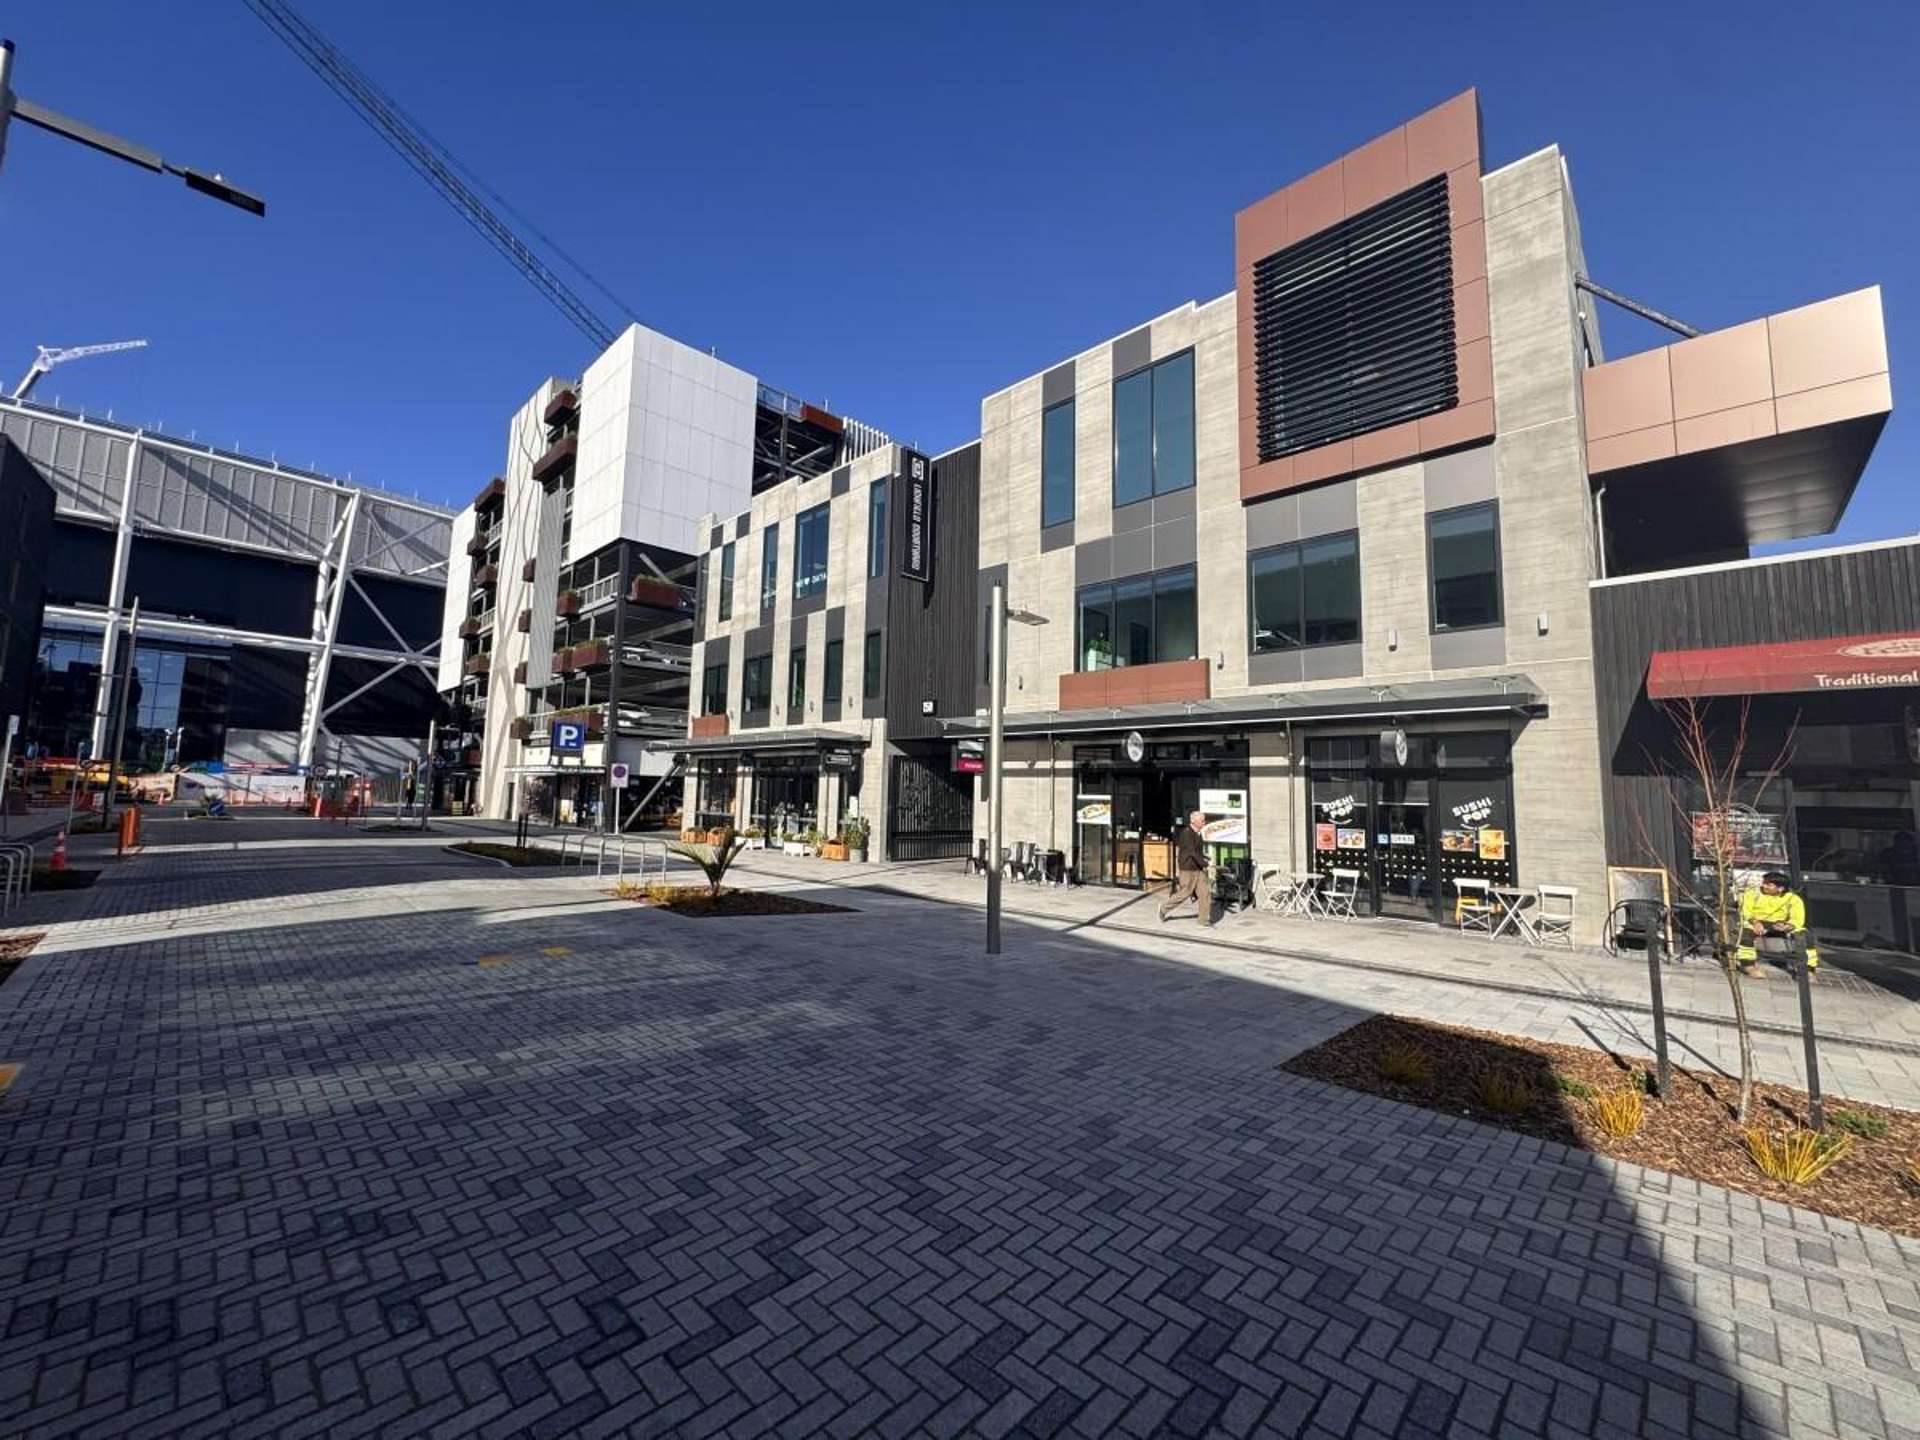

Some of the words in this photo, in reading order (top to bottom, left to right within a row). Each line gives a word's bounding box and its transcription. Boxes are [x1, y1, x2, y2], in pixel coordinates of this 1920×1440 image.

[1813, 670, 1919, 688] Traditional
[559, 724, 578, 747] P
[1322, 794, 1354, 813] SUSHI
[1329, 805, 1353, 819] POP
[1452, 796, 1492, 817] SUSHI
[1461, 807, 1491, 824] POP
